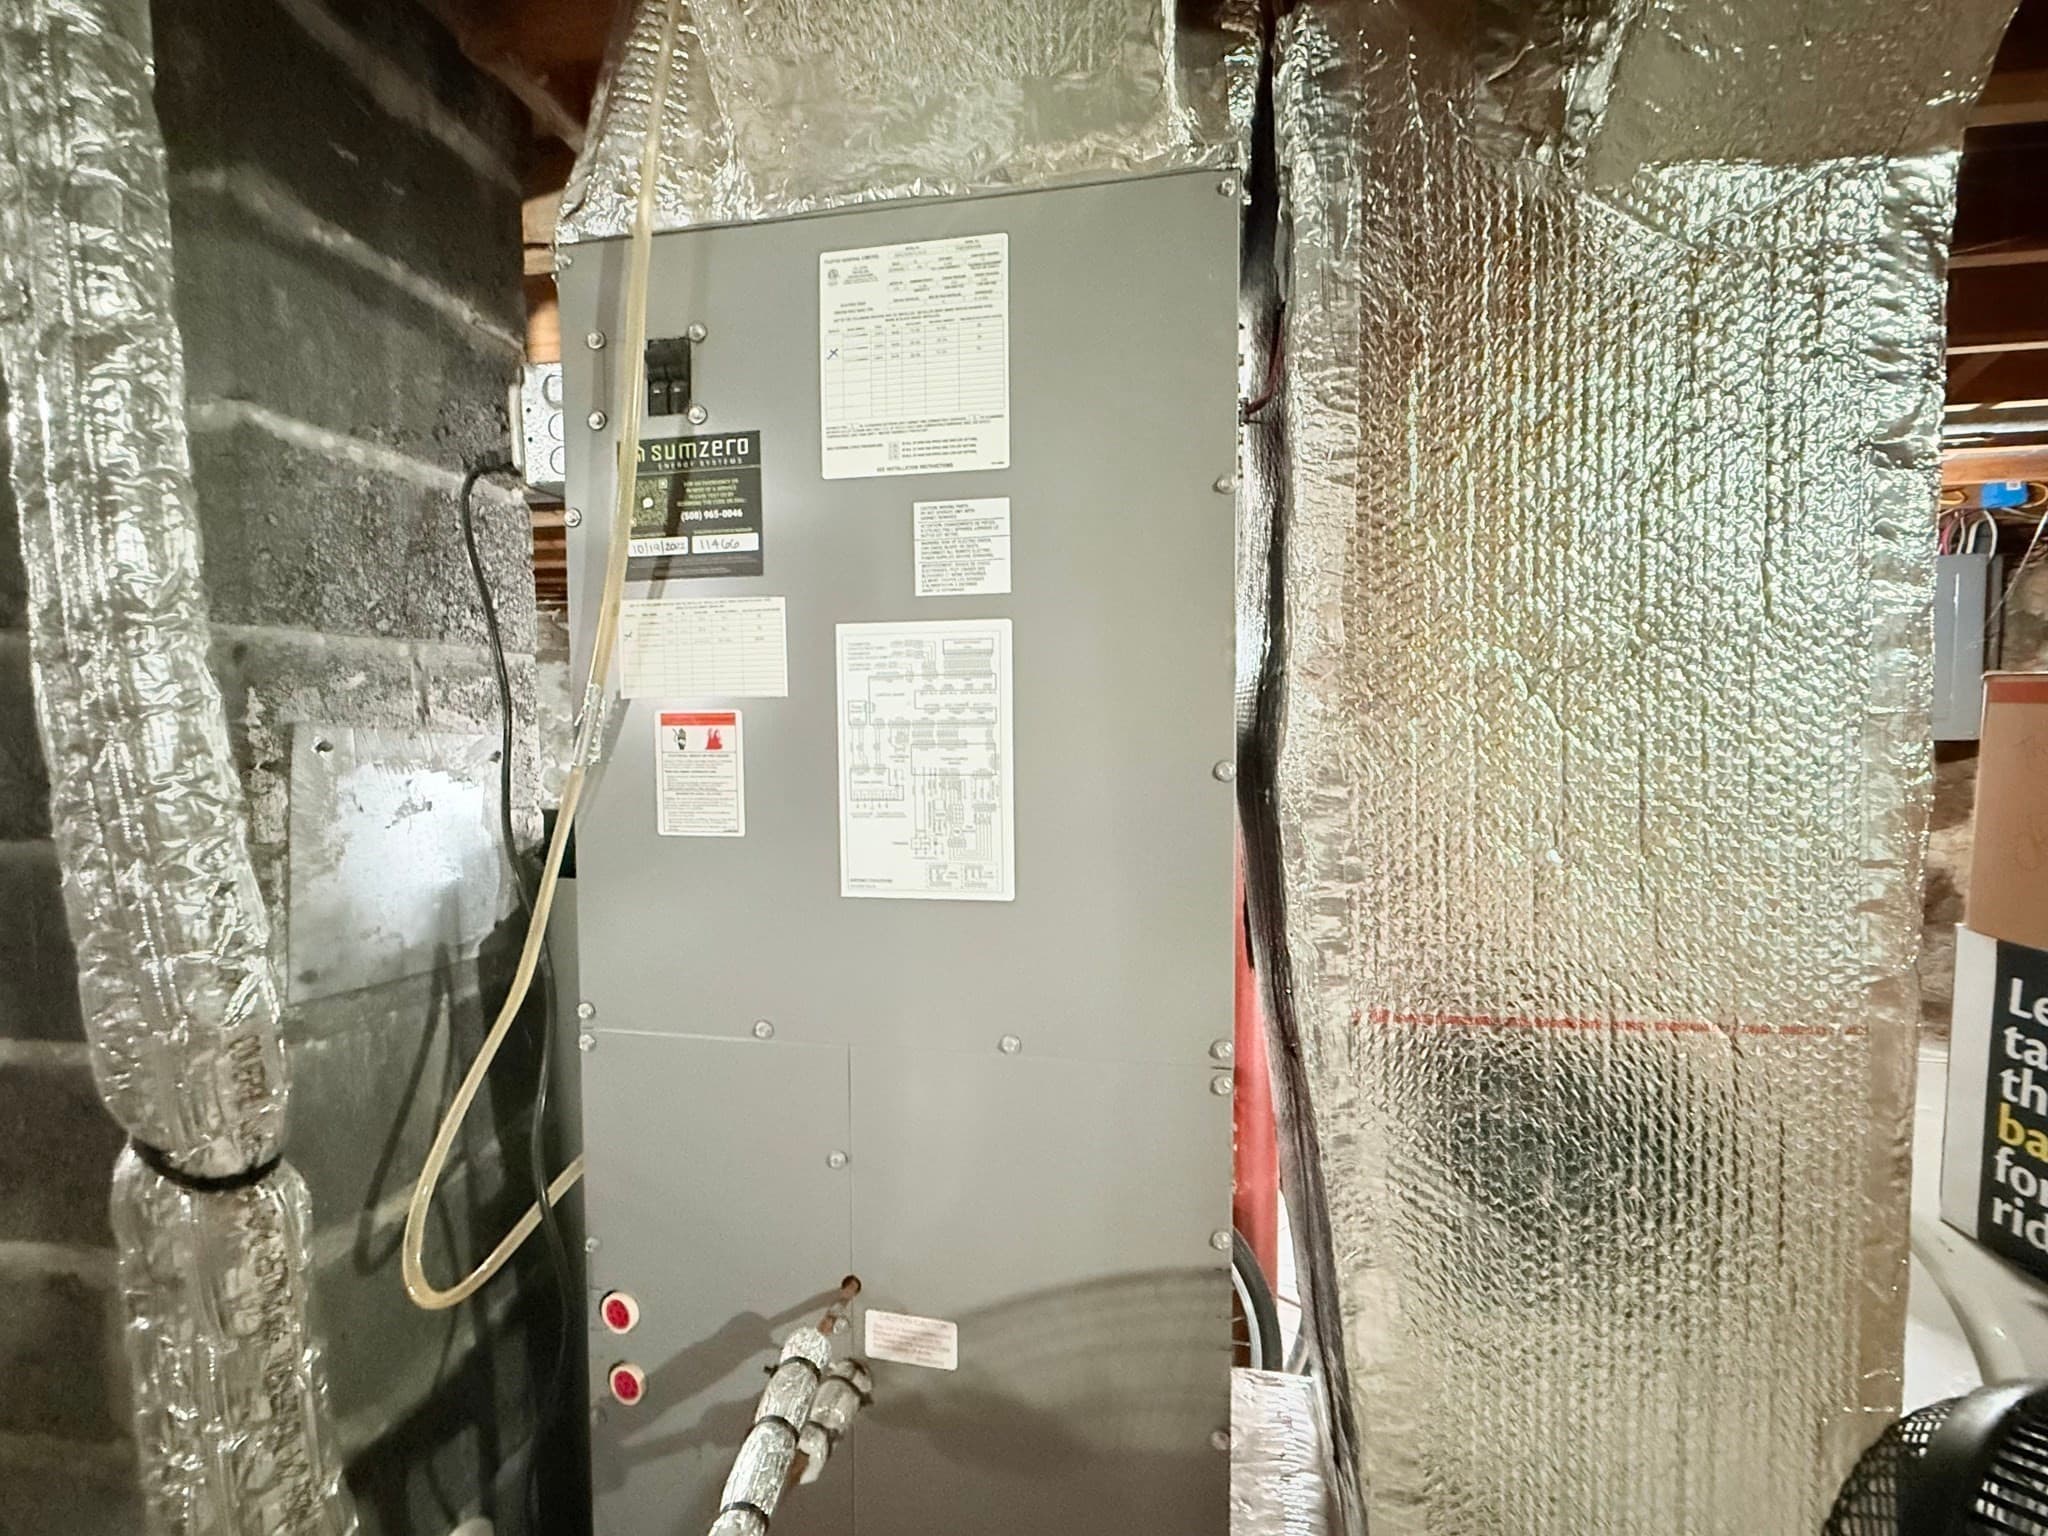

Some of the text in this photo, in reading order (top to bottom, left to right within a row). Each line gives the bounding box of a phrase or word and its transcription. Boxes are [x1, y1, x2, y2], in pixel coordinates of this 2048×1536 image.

[651, 438, 749, 461] sumzero
[699, 457, 743, 467] SYSTEMS
[2003, 1026, 2048, 1071] ta
[2000, 1068, 2048, 1116] th
[1997, 1102, 2048, 1164] ba
